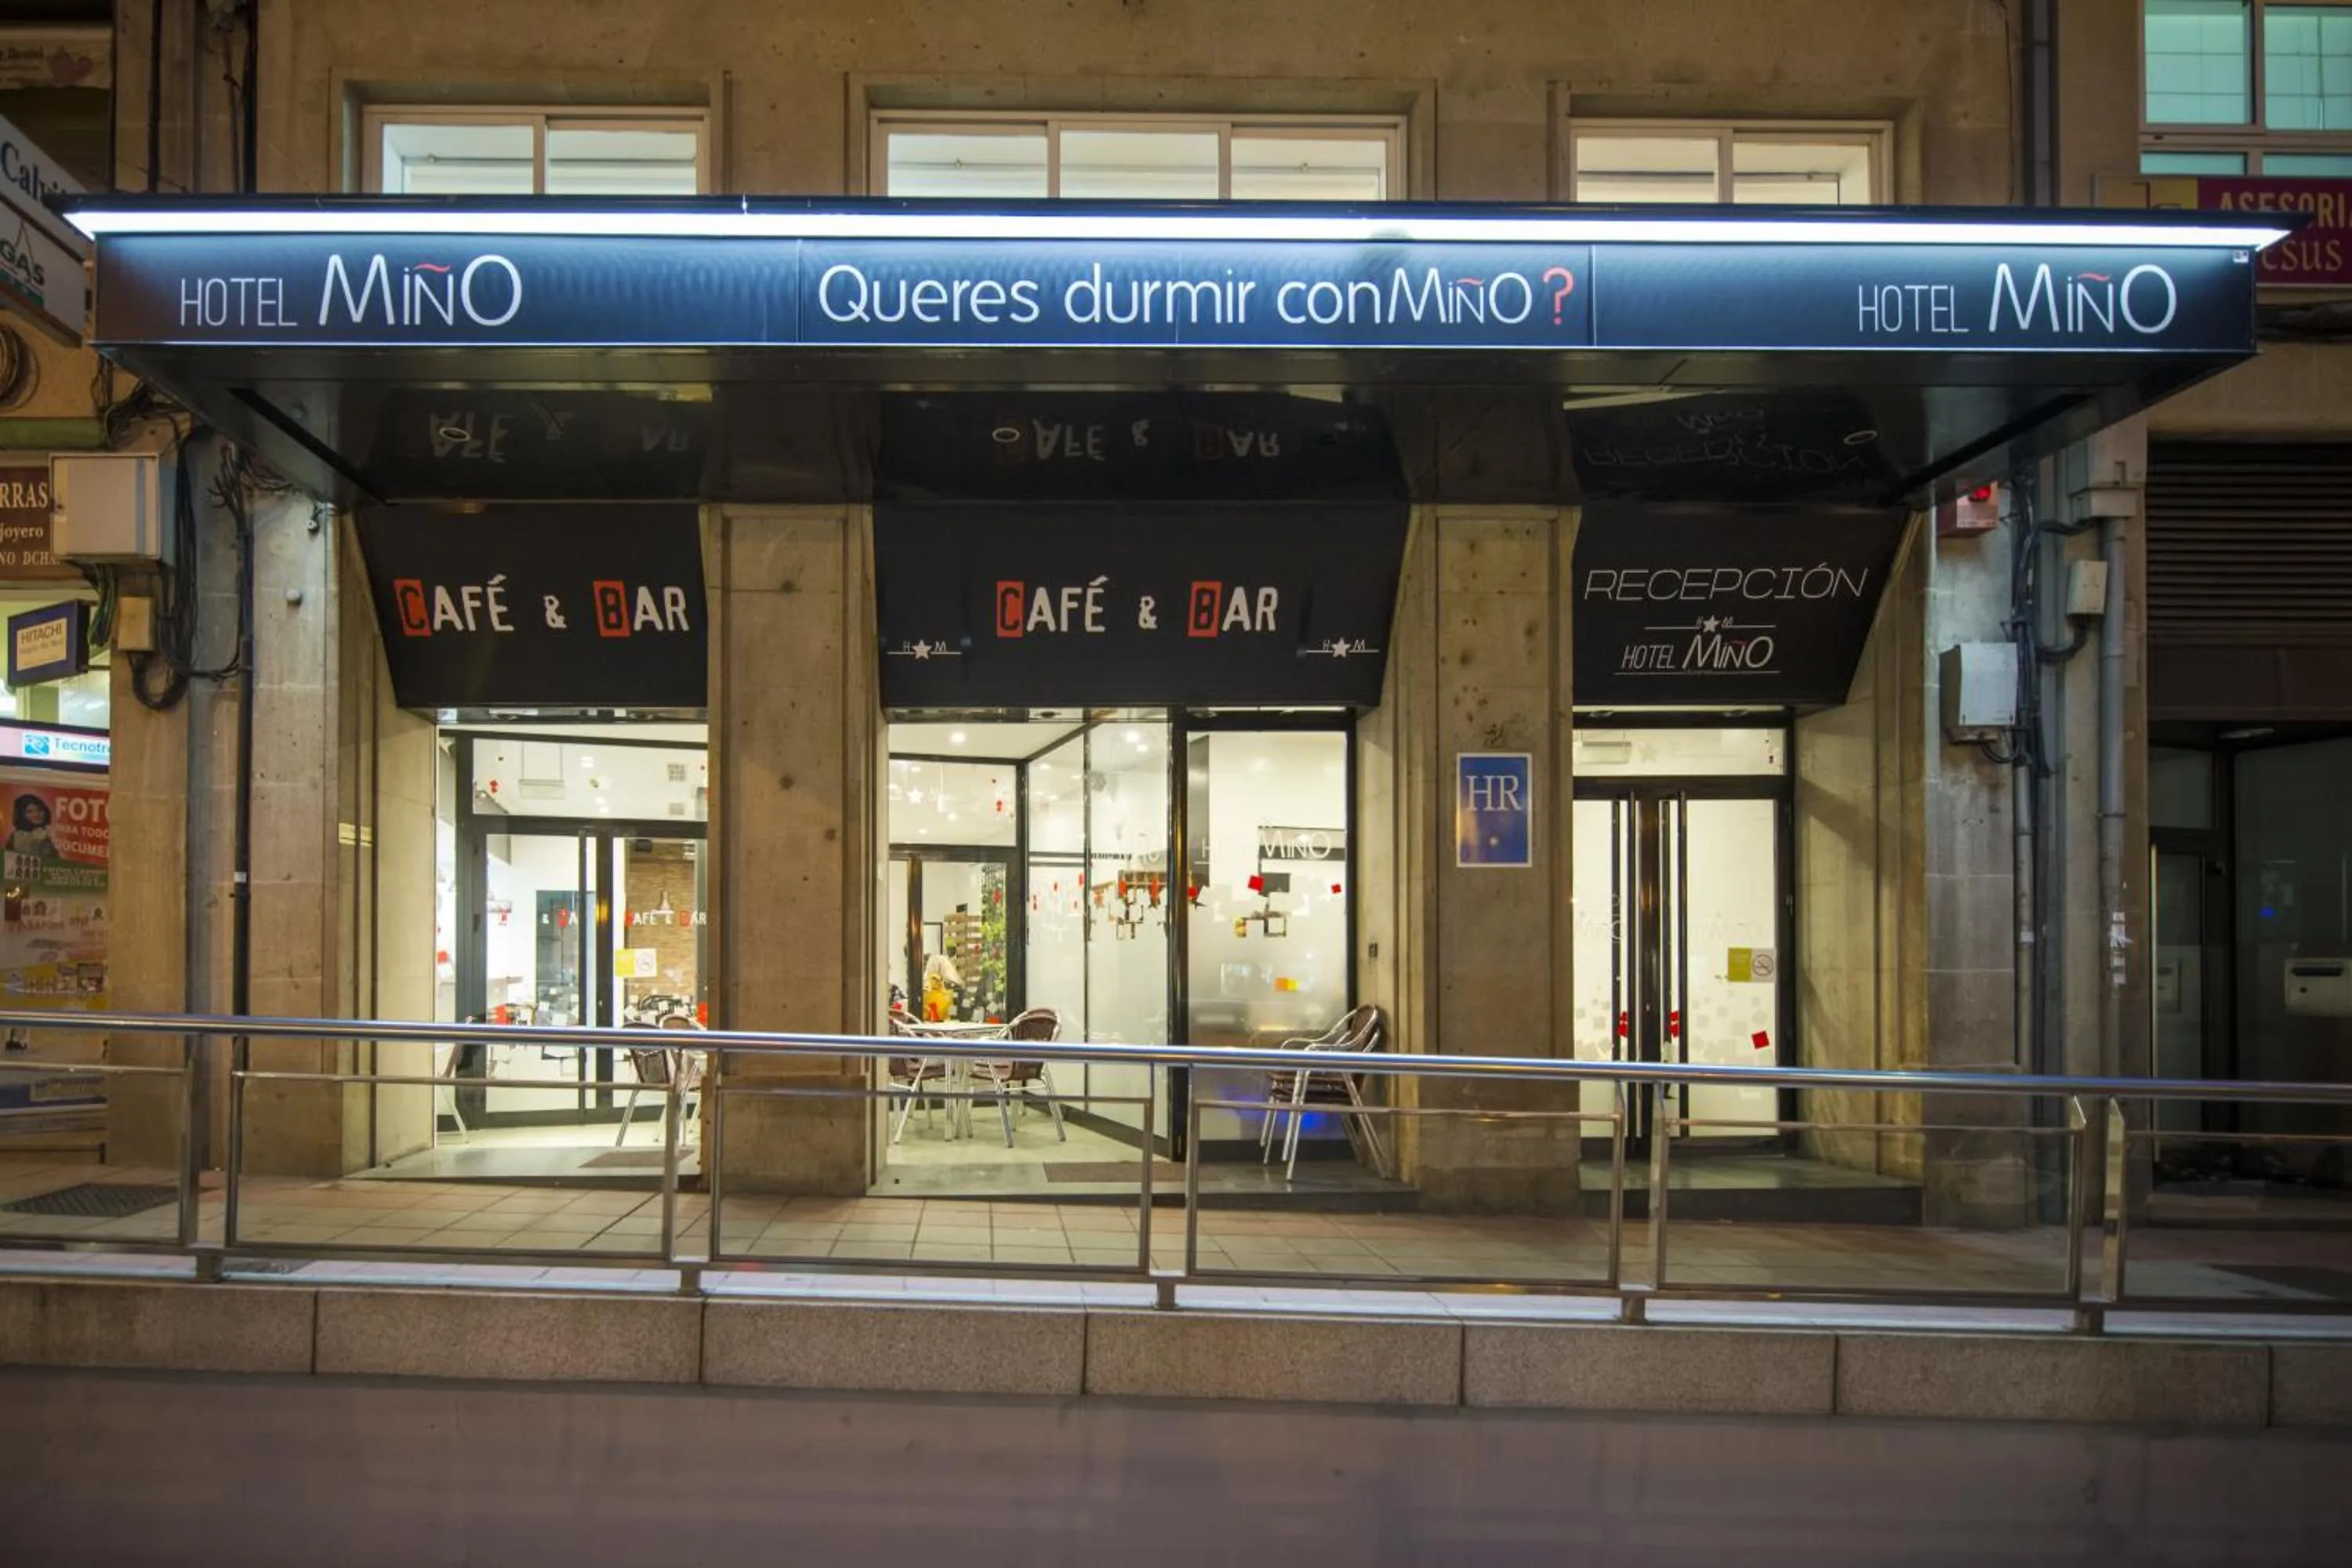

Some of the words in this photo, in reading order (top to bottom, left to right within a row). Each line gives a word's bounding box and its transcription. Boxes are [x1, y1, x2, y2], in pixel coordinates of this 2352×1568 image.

[2220, 191, 2352, 228] ASESORI
[180, 277, 298, 327] HOTEL
[818, 263, 1040, 324] Queres
[1064, 262, 1256, 325] durmir
[1858, 284, 1969, 333] HOTEL
[1584, 562, 1869, 601] RECEPCIÓN
[394, 574, 515, 637] CAFÉ
[543, 594, 568, 629] &
[593, 580, 690, 637] BAR
[996, 575, 1109, 637] CAFÉ
[1138, 595, 1158, 630] &
[1188, 581, 1279, 637] BAR
[20, 623, 62, 644] HITACHI
[1621, 644, 1676, 670] HOTEL
[54, 738, 109, 753] Tecnotr
[55, 797, 109, 822] FOT
[1465, 775, 1523, 811] HR
[56, 839, 109, 858] DOCUME
